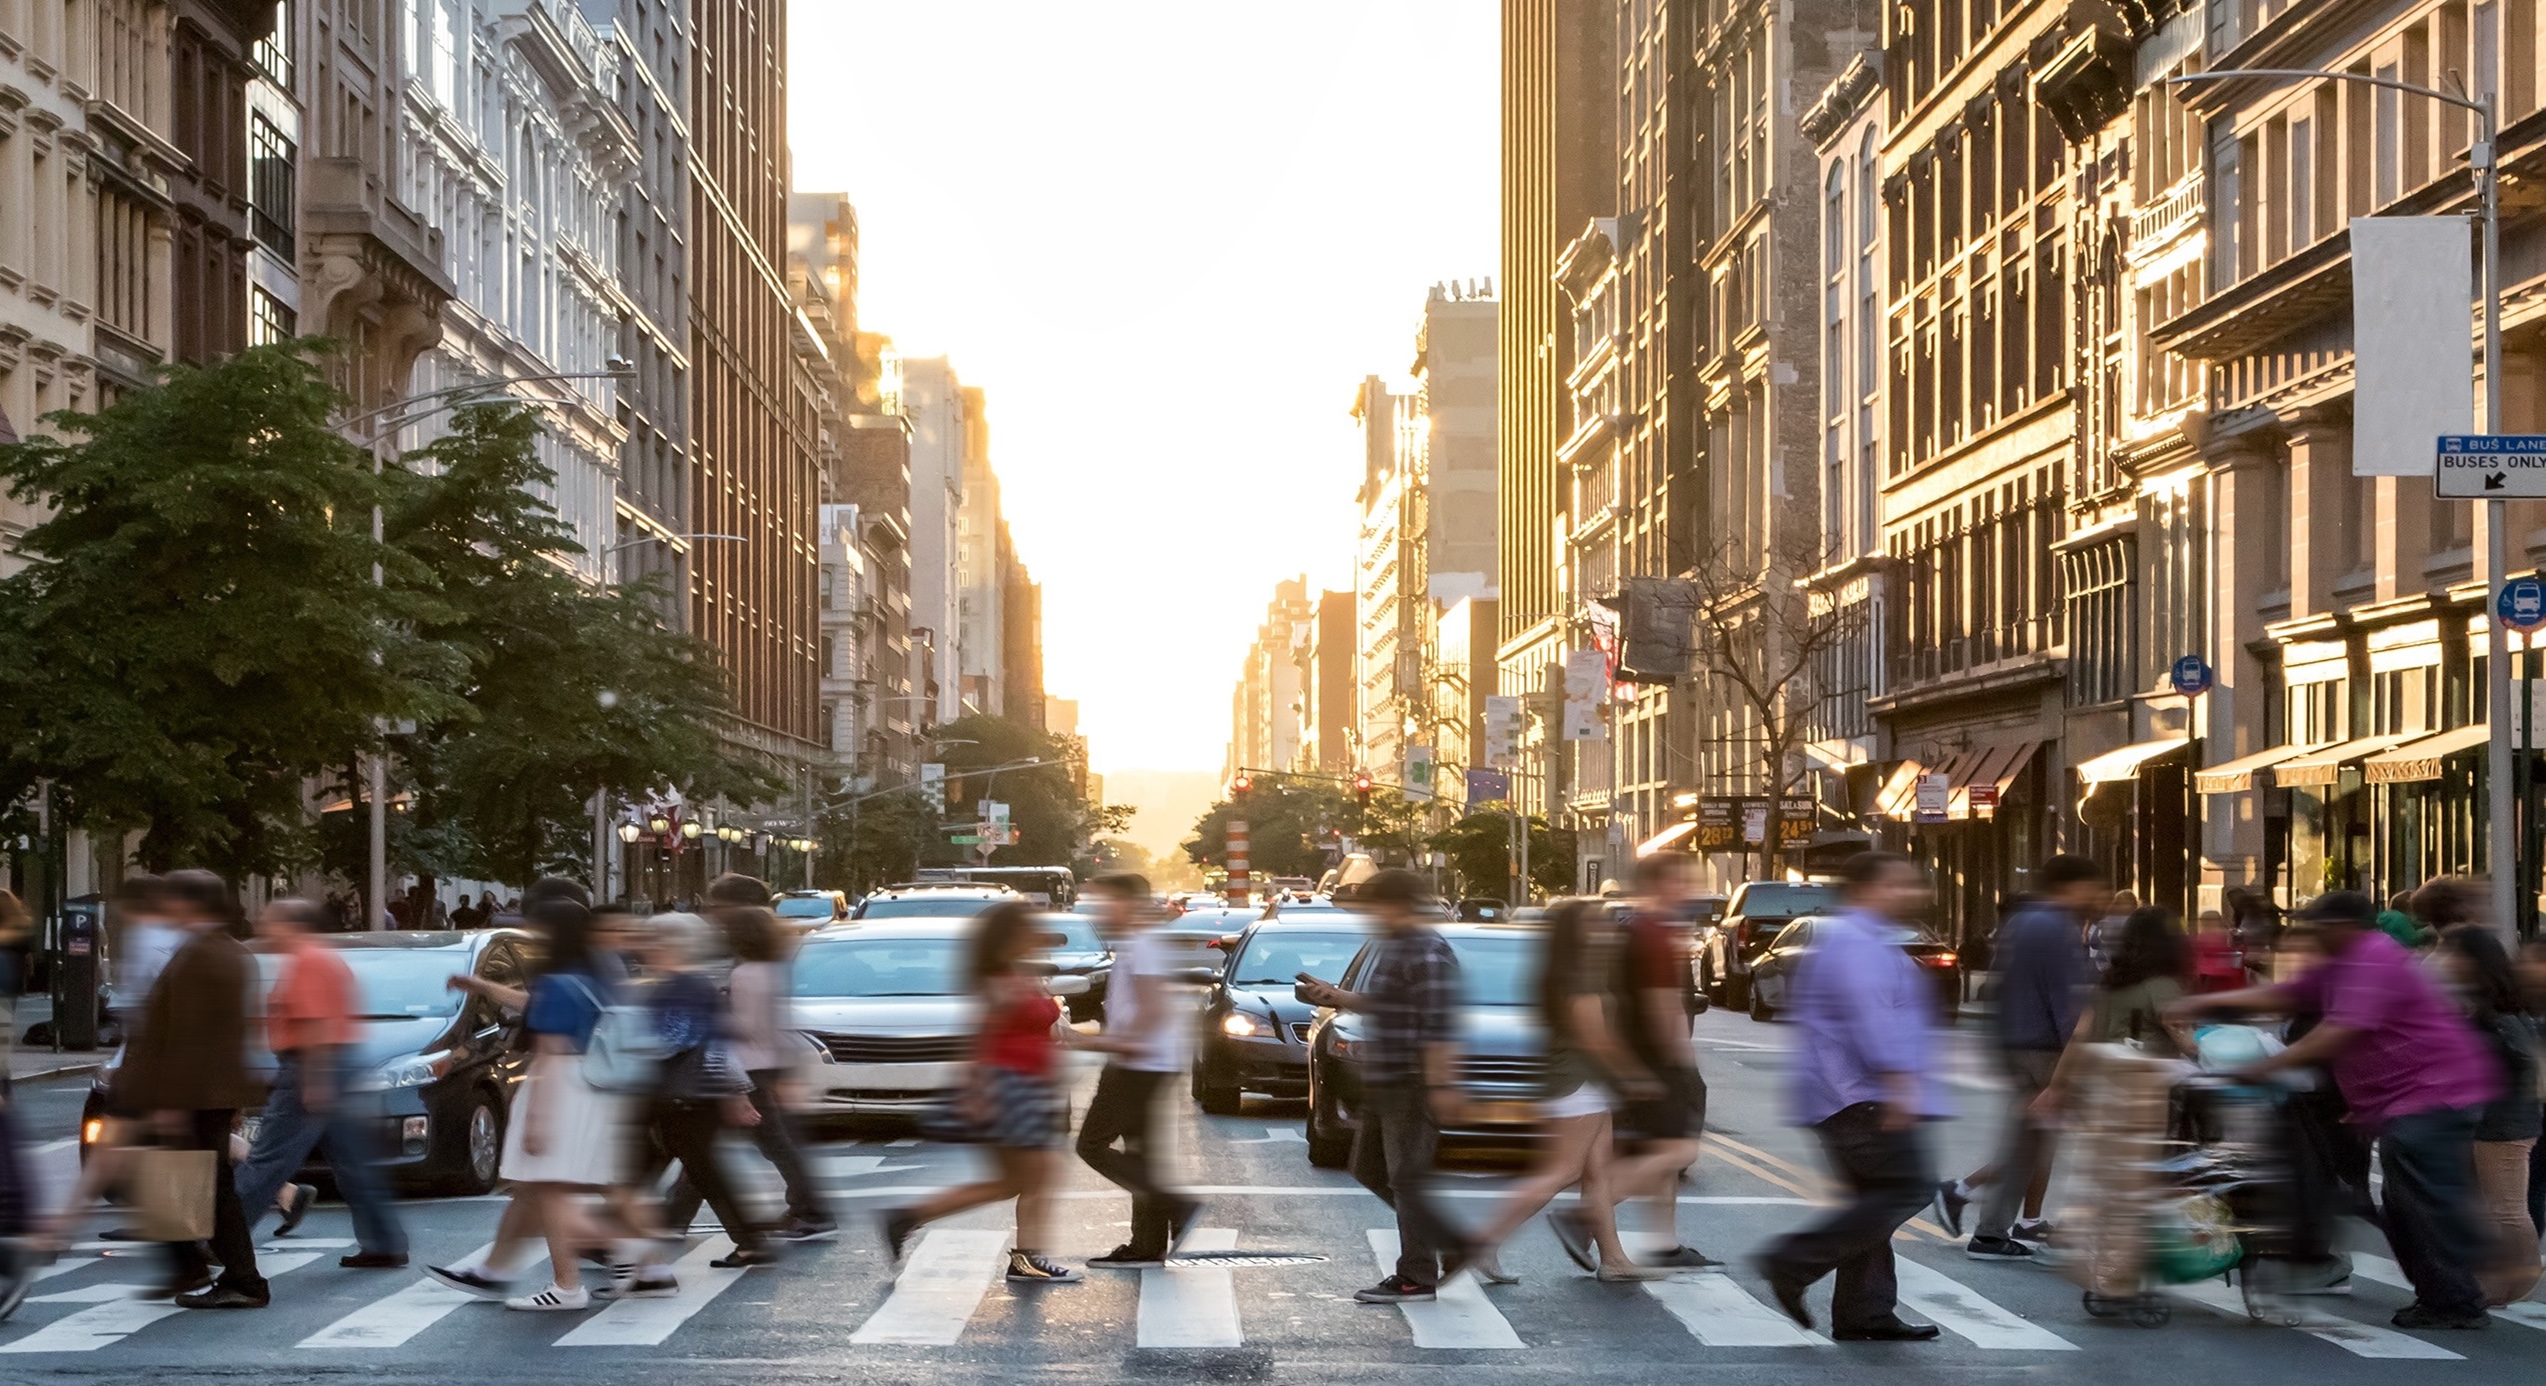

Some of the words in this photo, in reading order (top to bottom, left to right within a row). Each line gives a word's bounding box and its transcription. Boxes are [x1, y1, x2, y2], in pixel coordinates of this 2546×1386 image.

[2469, 440, 2500, 450] BUS
[2444, 456, 2499, 468] BUSES
[76, 915, 87, 928] P
